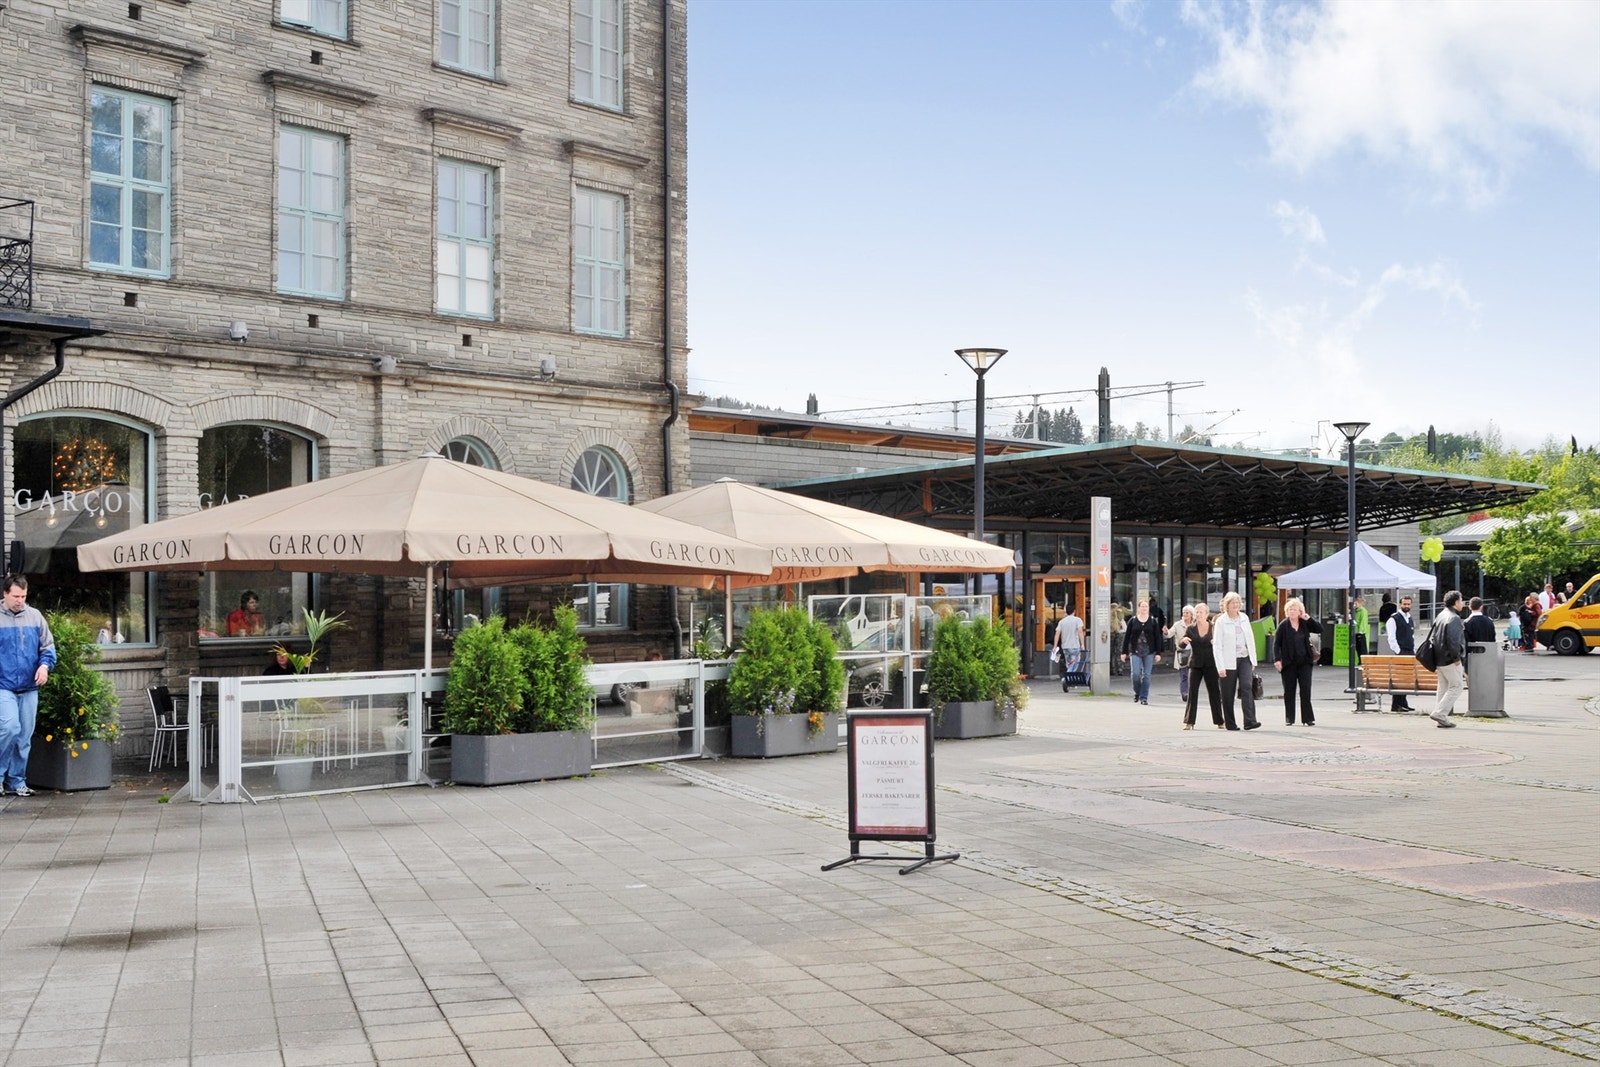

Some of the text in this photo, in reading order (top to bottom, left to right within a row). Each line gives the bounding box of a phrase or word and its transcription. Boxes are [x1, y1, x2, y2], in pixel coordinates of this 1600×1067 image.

[14, 488, 145, 517] GARÇON
[113, 538, 192, 565] GARÇON
[269, 534, 365, 558] GARÇON
[456, 533, 564, 559] GARÇON
[650, 540, 736, 566] GARÇON
[861, 735, 920, 747] GARÇON
